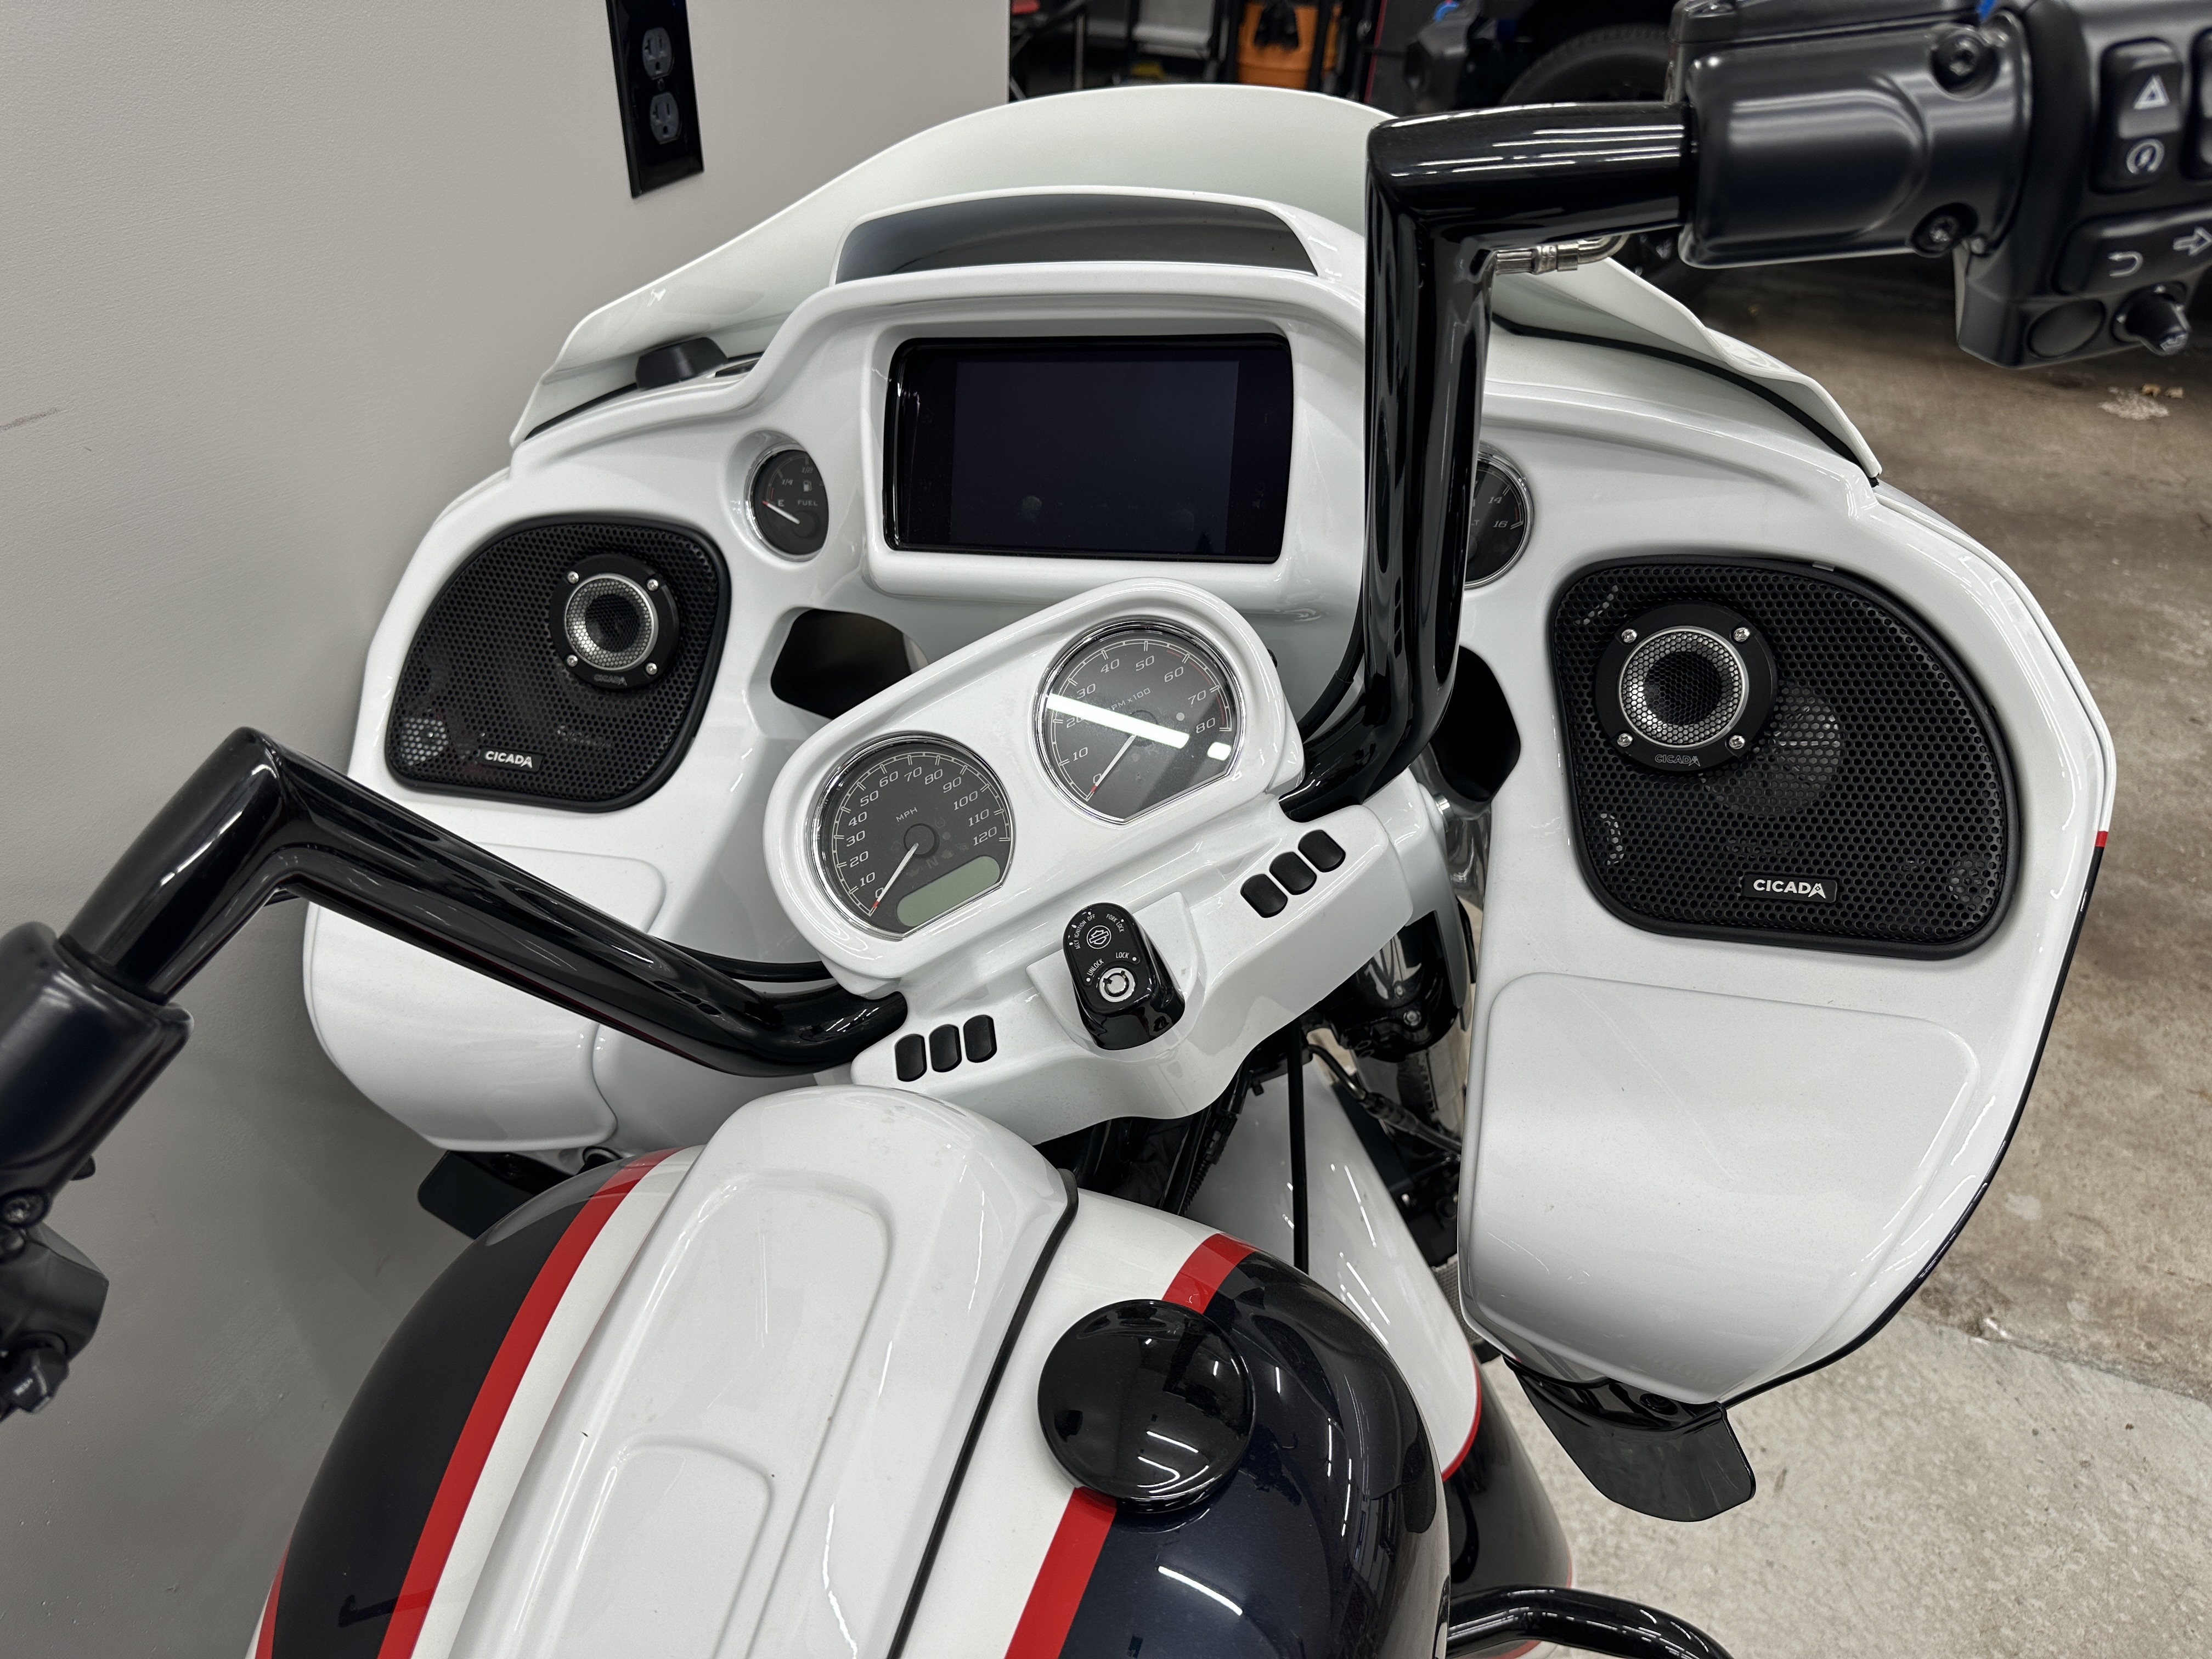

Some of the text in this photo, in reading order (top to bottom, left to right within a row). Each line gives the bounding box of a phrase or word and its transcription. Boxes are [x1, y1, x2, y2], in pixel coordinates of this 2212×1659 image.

[778, 499, 785, 507] E
[1101, 658, 1120, 673] 40
[1135, 656, 1155, 672] 50
[1164, 667, 1184, 683] 60
[1076, 683, 1096, 699] 30
[1127, 687, 1151, 703] x100
[1188, 690, 1206, 706] 70
[1195, 717, 1216, 734] 80
[484, 750, 533, 769] CICADA
[1073, 747, 1088, 761] 10
[1655, 754, 1700, 767] CICADA
[879, 771, 899, 788] 60
[904, 766, 922, 782] 70
[924, 769, 943, 785] 80
[943, 776, 962, 793] 90
[860, 791, 879, 808] 50
[953, 791, 979, 811] 100
[848, 811, 867, 827] 40
[896, 807, 918, 822] MPH
[968, 809, 989, 827] 110
[846, 830, 866, 847] 30
[973, 827, 997, 846] 120
[849, 850, 868, 868] 20
[860, 872, 876, 888] 10
[875, 887, 884, 899] 0
[1753, 879, 1826, 899] CICADA
[1074, 919, 1087, 938] IGNITION
[1106, 913, 1125, 933] FORK LOCK
[1086, 958, 1104, 976] UNLOCK
